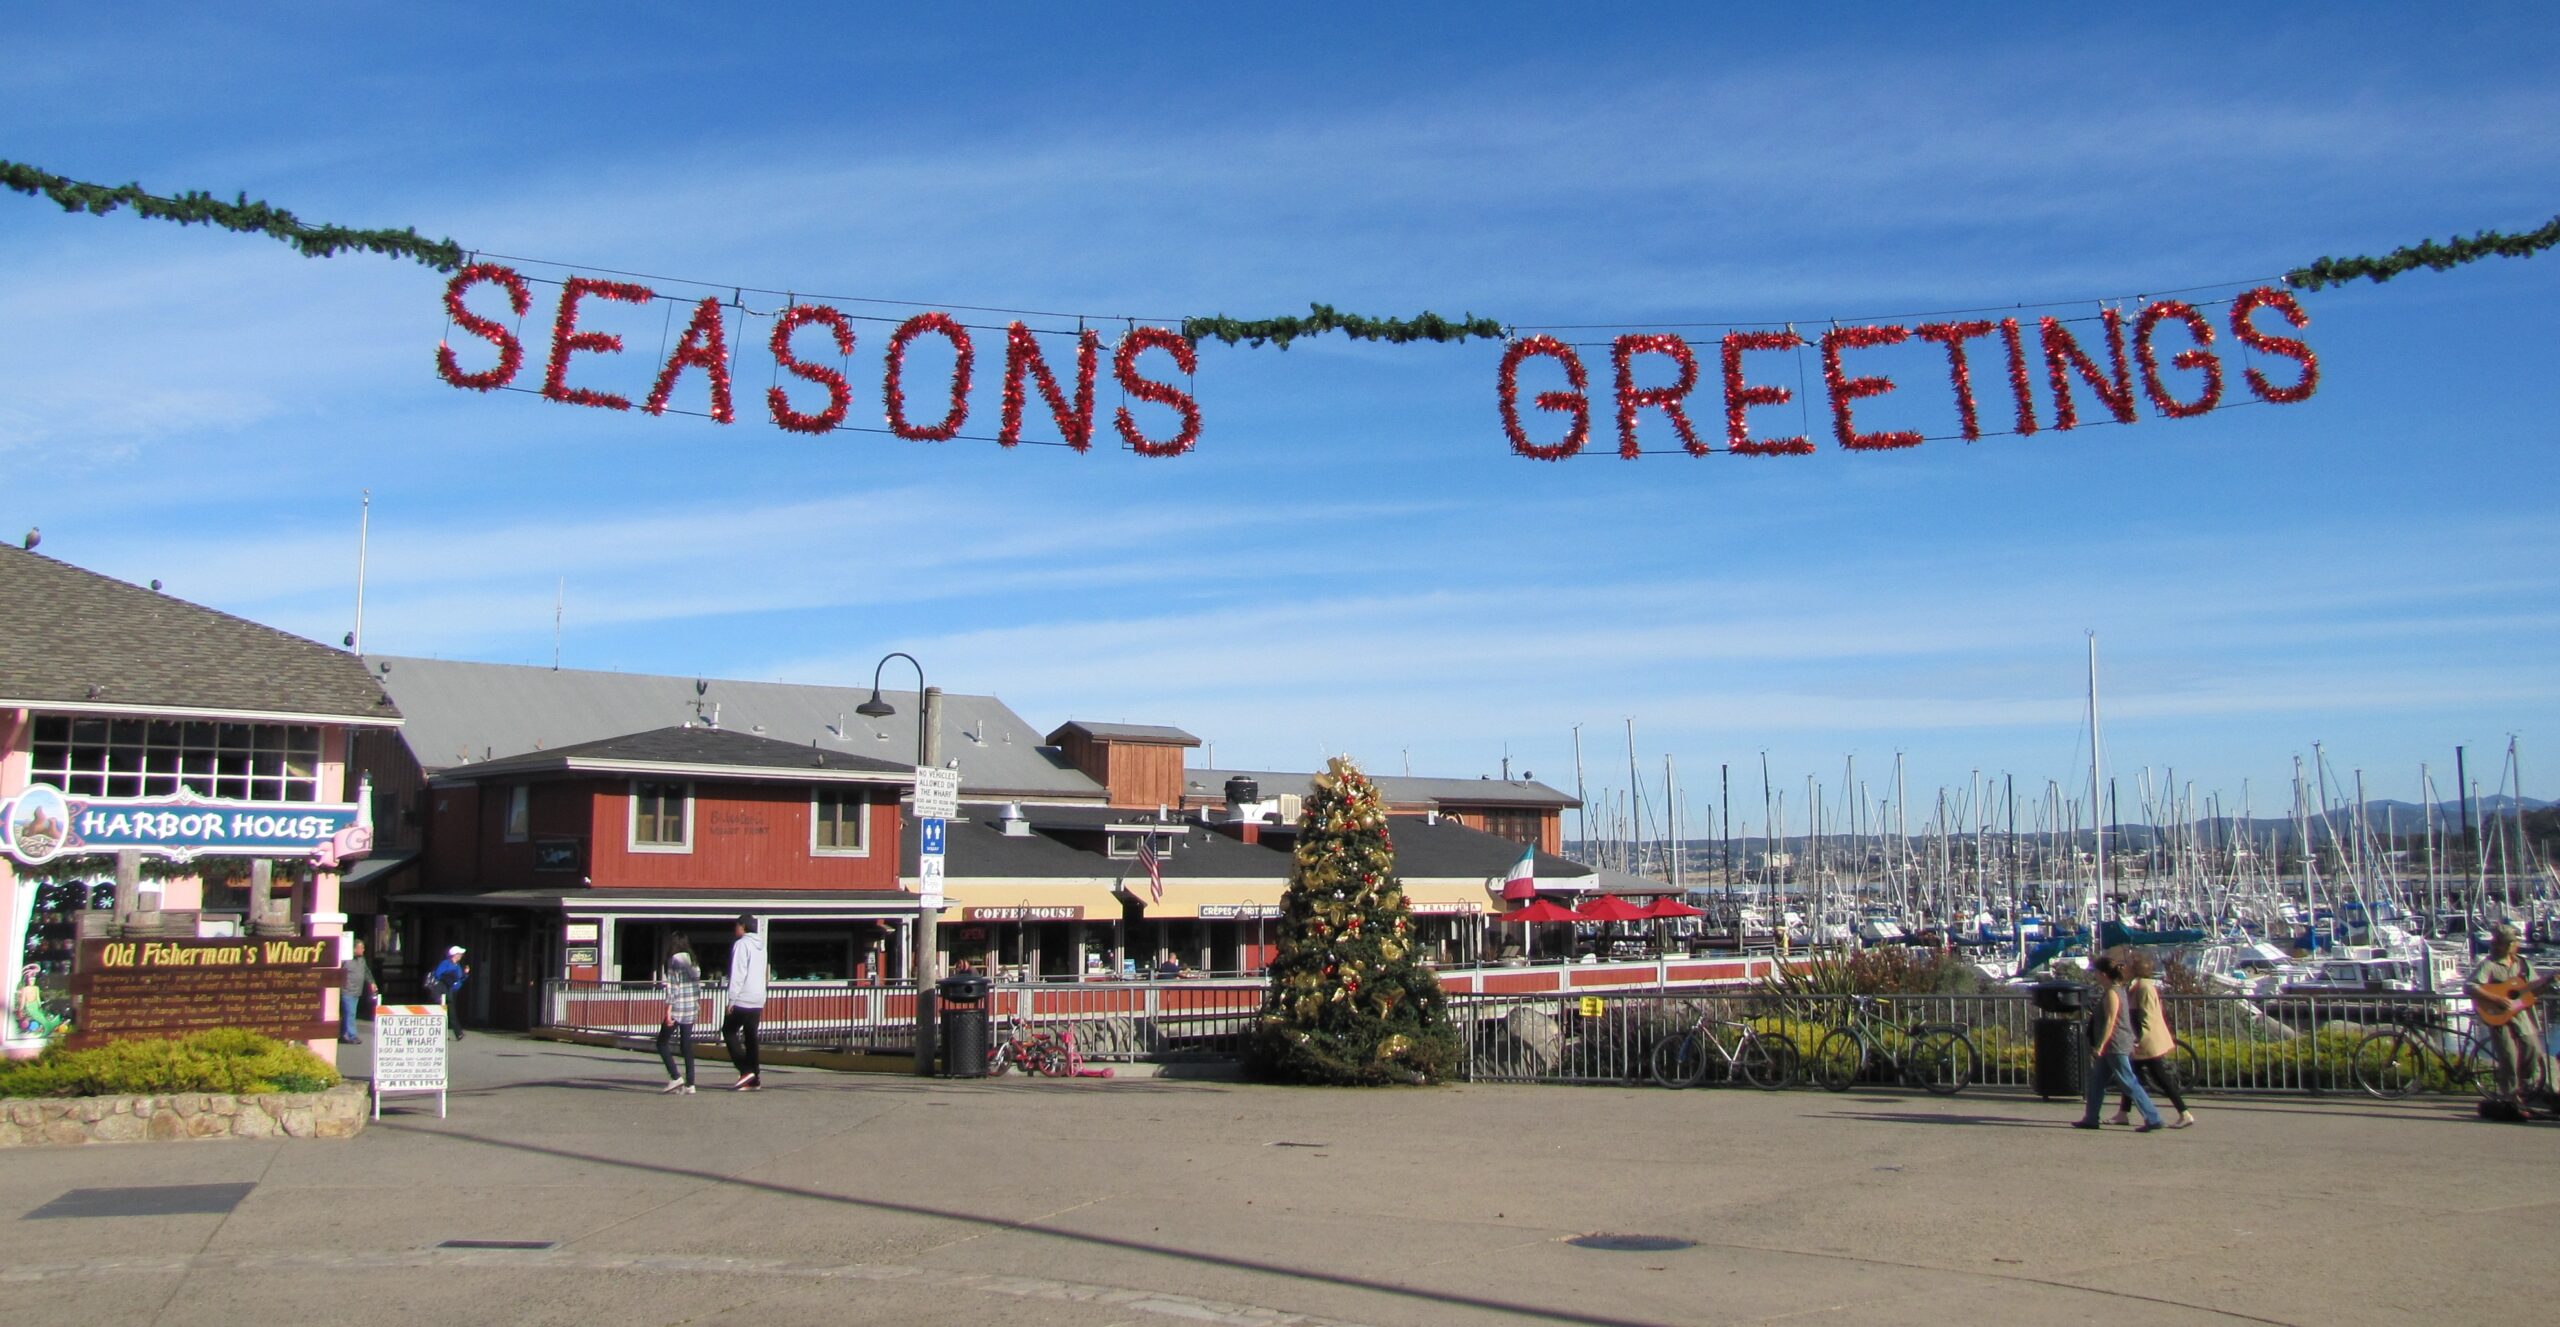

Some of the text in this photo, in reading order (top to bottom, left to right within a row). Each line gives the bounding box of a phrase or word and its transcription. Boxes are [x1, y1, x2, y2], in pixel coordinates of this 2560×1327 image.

[437, 262, 2319, 461] SEASONS GREETINGS
[929, 771, 955, 779] VEHICLES
[920, 779, 944, 787] ALLOWED
[82, 810, 335, 840] HARBOR HOUSE
[974, 907, 1075, 919] COFFEE HOUSE
[1203, 905, 1231, 916] CRÊPES
[1242, 907, 1280, 915] BRITANY!
[102, 941, 326, 968] Old Fisherman's Wharf
[381, 1017, 443, 1027] NO VEHICLES
[382, 1027, 441, 1036] ALLOWED ON
[385, 1037, 437, 1046] THE WHARF
